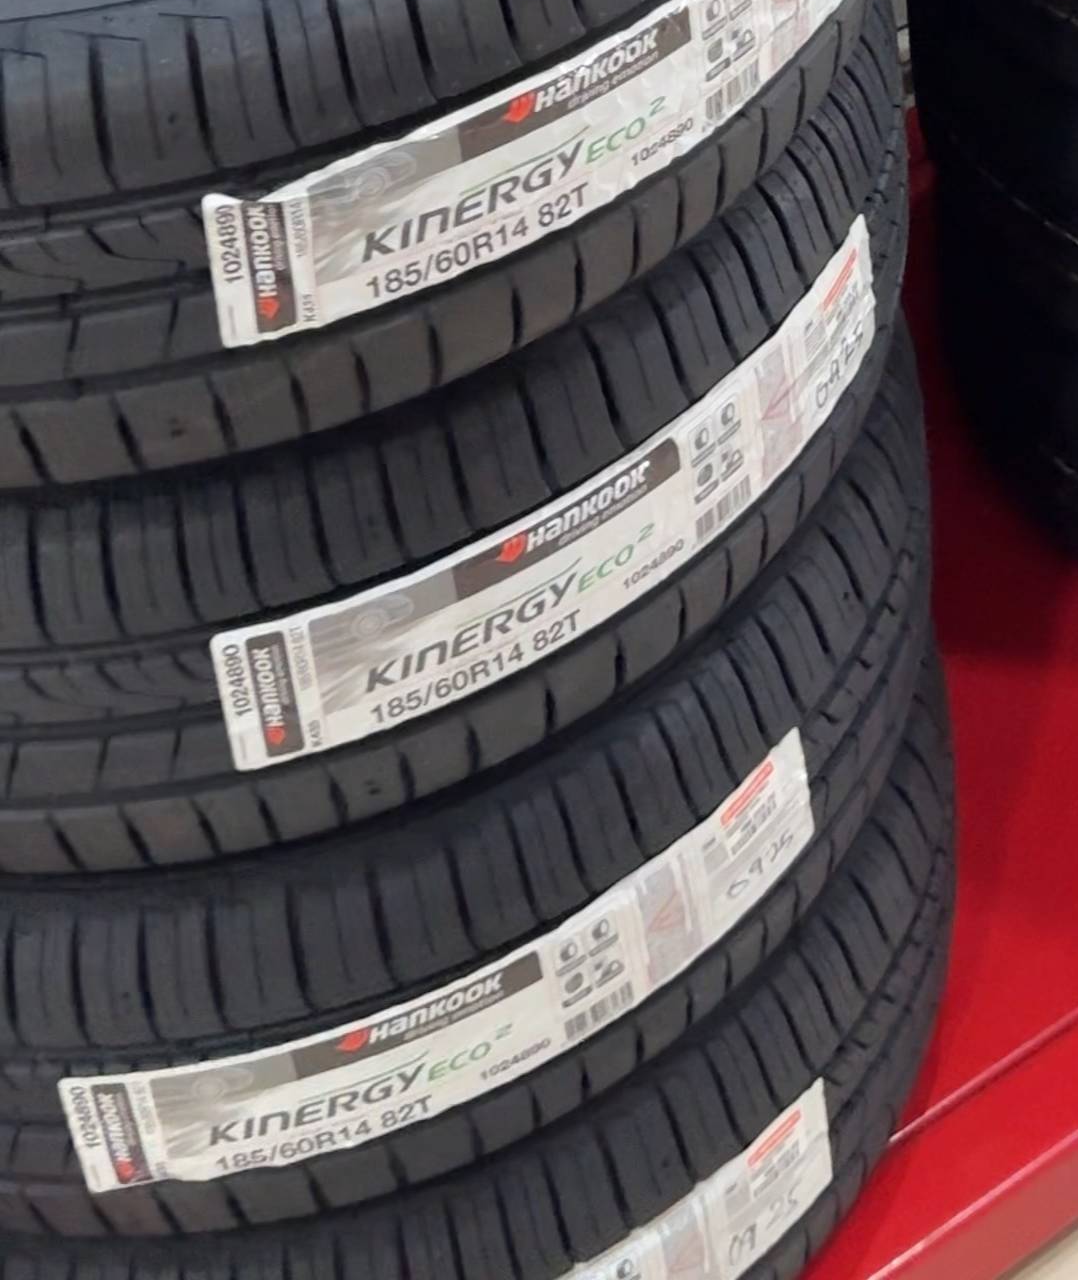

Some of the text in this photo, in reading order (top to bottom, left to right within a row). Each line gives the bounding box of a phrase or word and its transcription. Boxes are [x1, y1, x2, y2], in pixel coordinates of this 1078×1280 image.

[631, 117, 694, 166] 1024890
[360, 139, 584, 264] KINERGY
[366, 183, 590, 299] 185/60R14 82T
[215, 204, 244, 285] 1024890
[623, 538, 685, 589] 1024890
[365, 573, 578, 692] KINERGY
[370, 610, 581, 725] 185/60R14 82T
[221, 644, 252, 718] 1024890
[71, 1086, 99, 1148] 1024890
[210, 1062, 427, 1146] KINERGY
[216, 1094, 432, 1171] 185/60R14 82T
